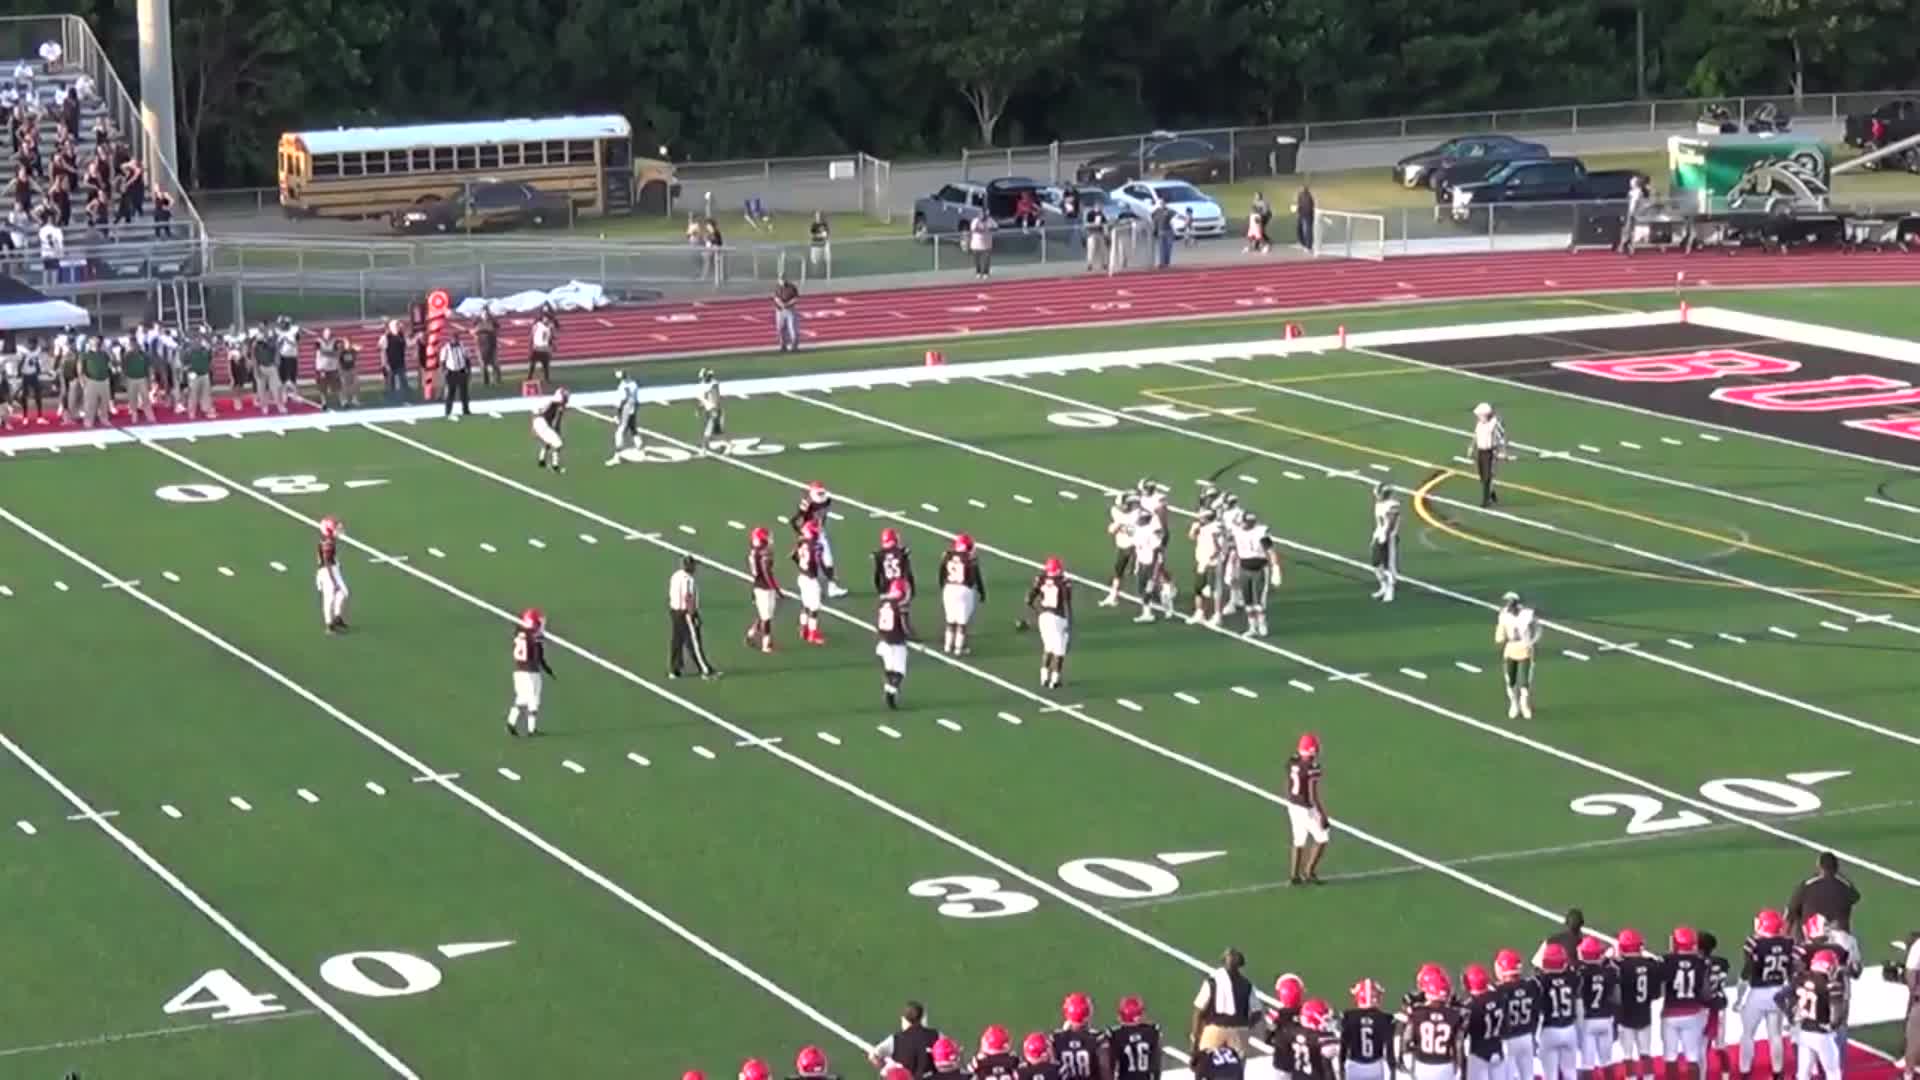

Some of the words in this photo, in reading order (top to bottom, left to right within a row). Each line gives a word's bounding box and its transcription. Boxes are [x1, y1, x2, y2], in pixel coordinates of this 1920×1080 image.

[1551, 348, 1920, 441] BU
[1569, 778, 1823, 835] 20
[907, 857, 1180, 919] 30
[163, 951, 443, 1020] 40
[1591, 983, 1604, 1009] 7
[1635, 974, 1649, 1004] 9
[1673, 968, 1697, 999] 41
[1508, 997, 1533, 1025] 55
[1549, 986, 1572, 1018] 15
[1419, 1020, 1451, 1055] 82
[1483, 1008, 1504, 1040] 17
[1123, 1041, 1151, 1072] 16
[1360, 1026, 1374, 1058] 6
